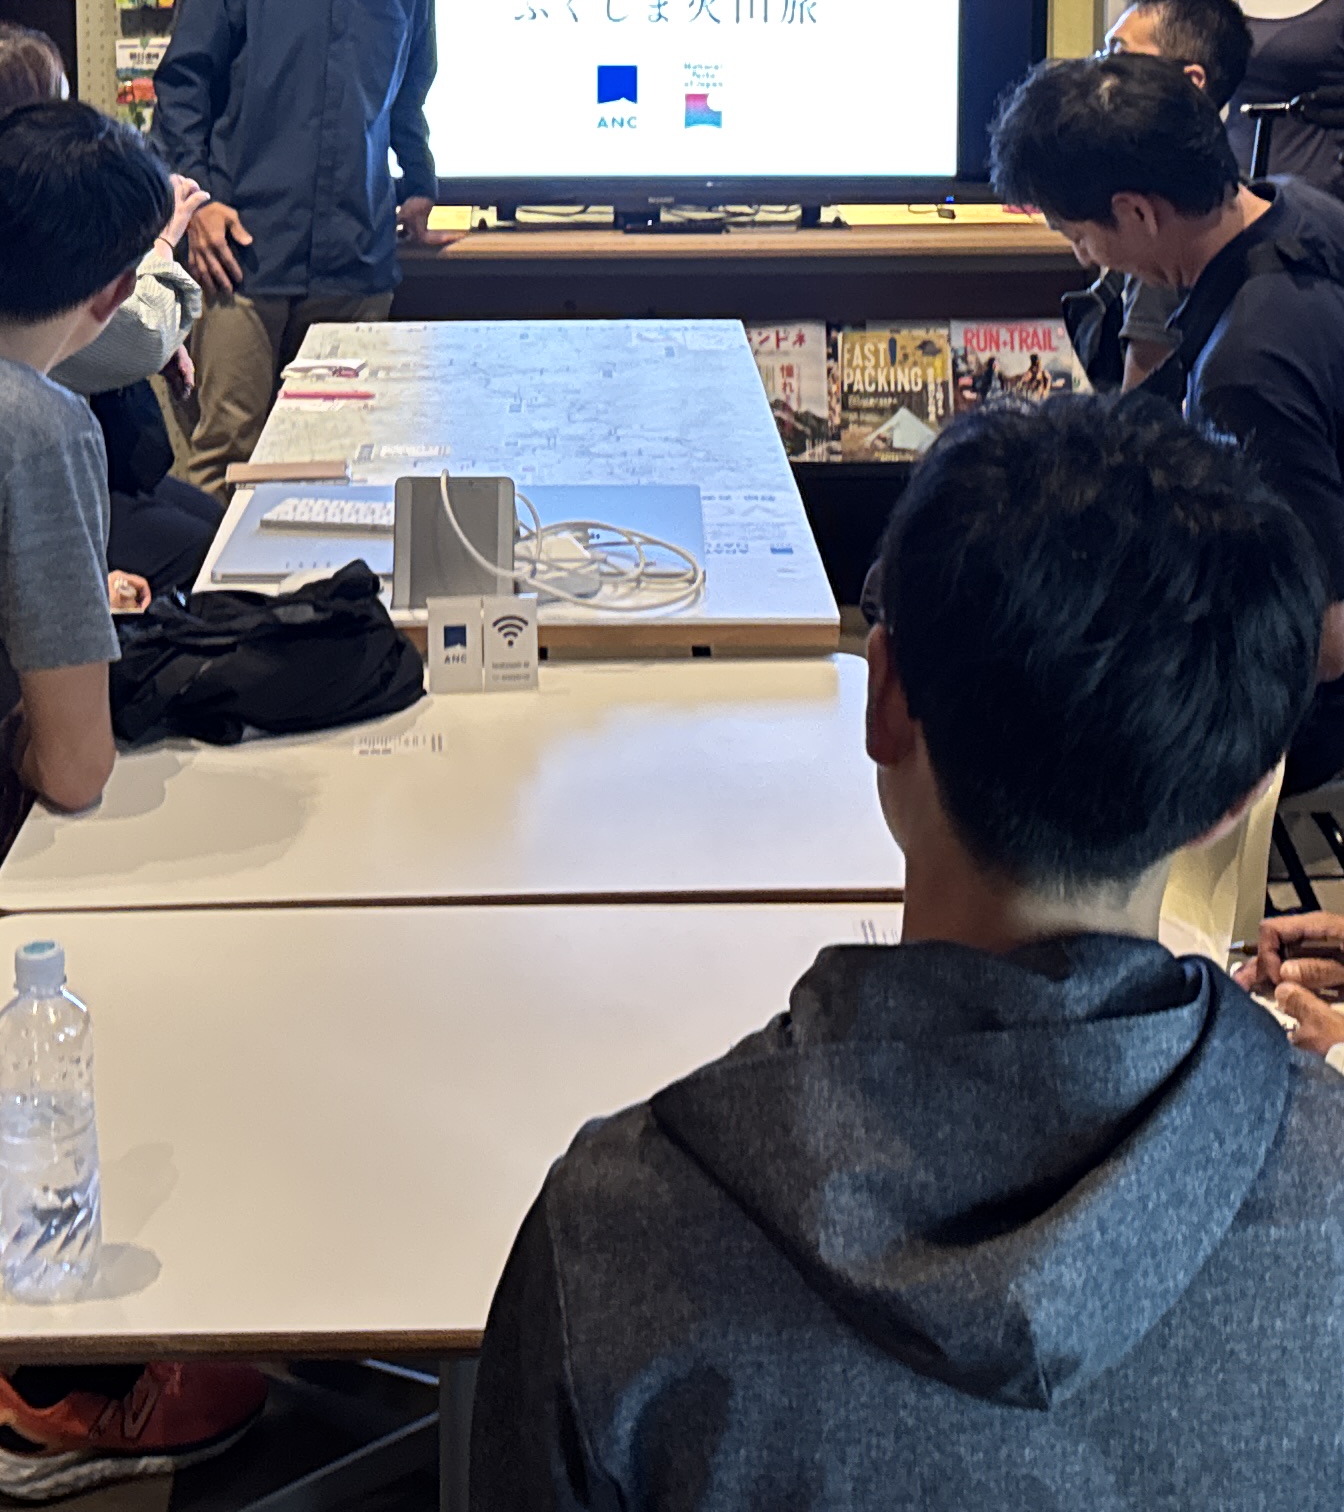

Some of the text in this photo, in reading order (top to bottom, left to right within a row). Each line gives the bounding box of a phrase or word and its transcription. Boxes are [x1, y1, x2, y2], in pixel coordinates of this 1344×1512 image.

[597, 116, 637, 128] ANC
[843, 342, 887, 368] FAST
[843, 366, 923, 393] PACKING
